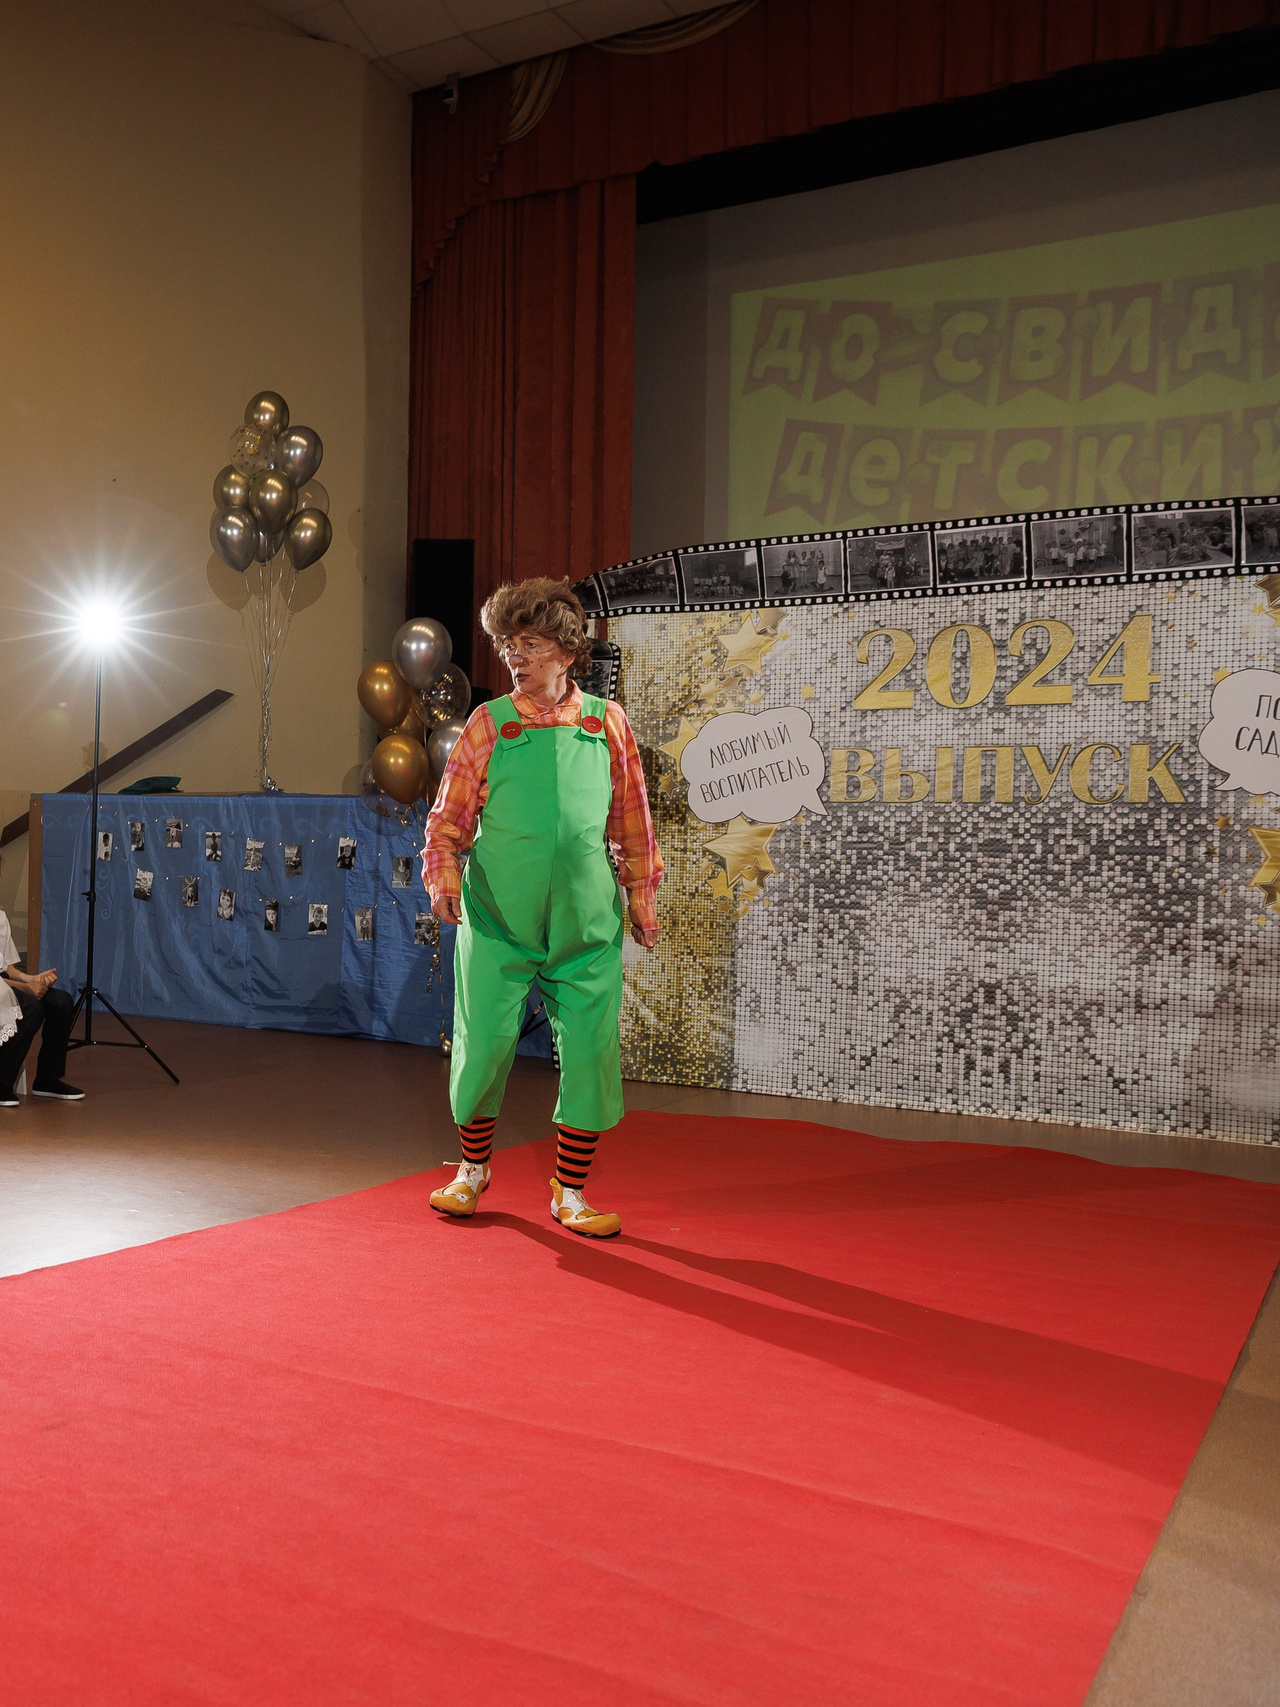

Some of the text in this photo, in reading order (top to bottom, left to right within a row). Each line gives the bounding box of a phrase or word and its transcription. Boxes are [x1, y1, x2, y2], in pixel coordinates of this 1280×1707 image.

[933, 284, 1280, 384] СВИД
[851, 614, 1162, 711] 2024
[709, 721, 792, 769] ЛЮБИМЫЙ
[828, 741, 1188, 806] ВЫПУСК
[699, 756, 810, 804] ВОСПИТАТЕЛЬ
